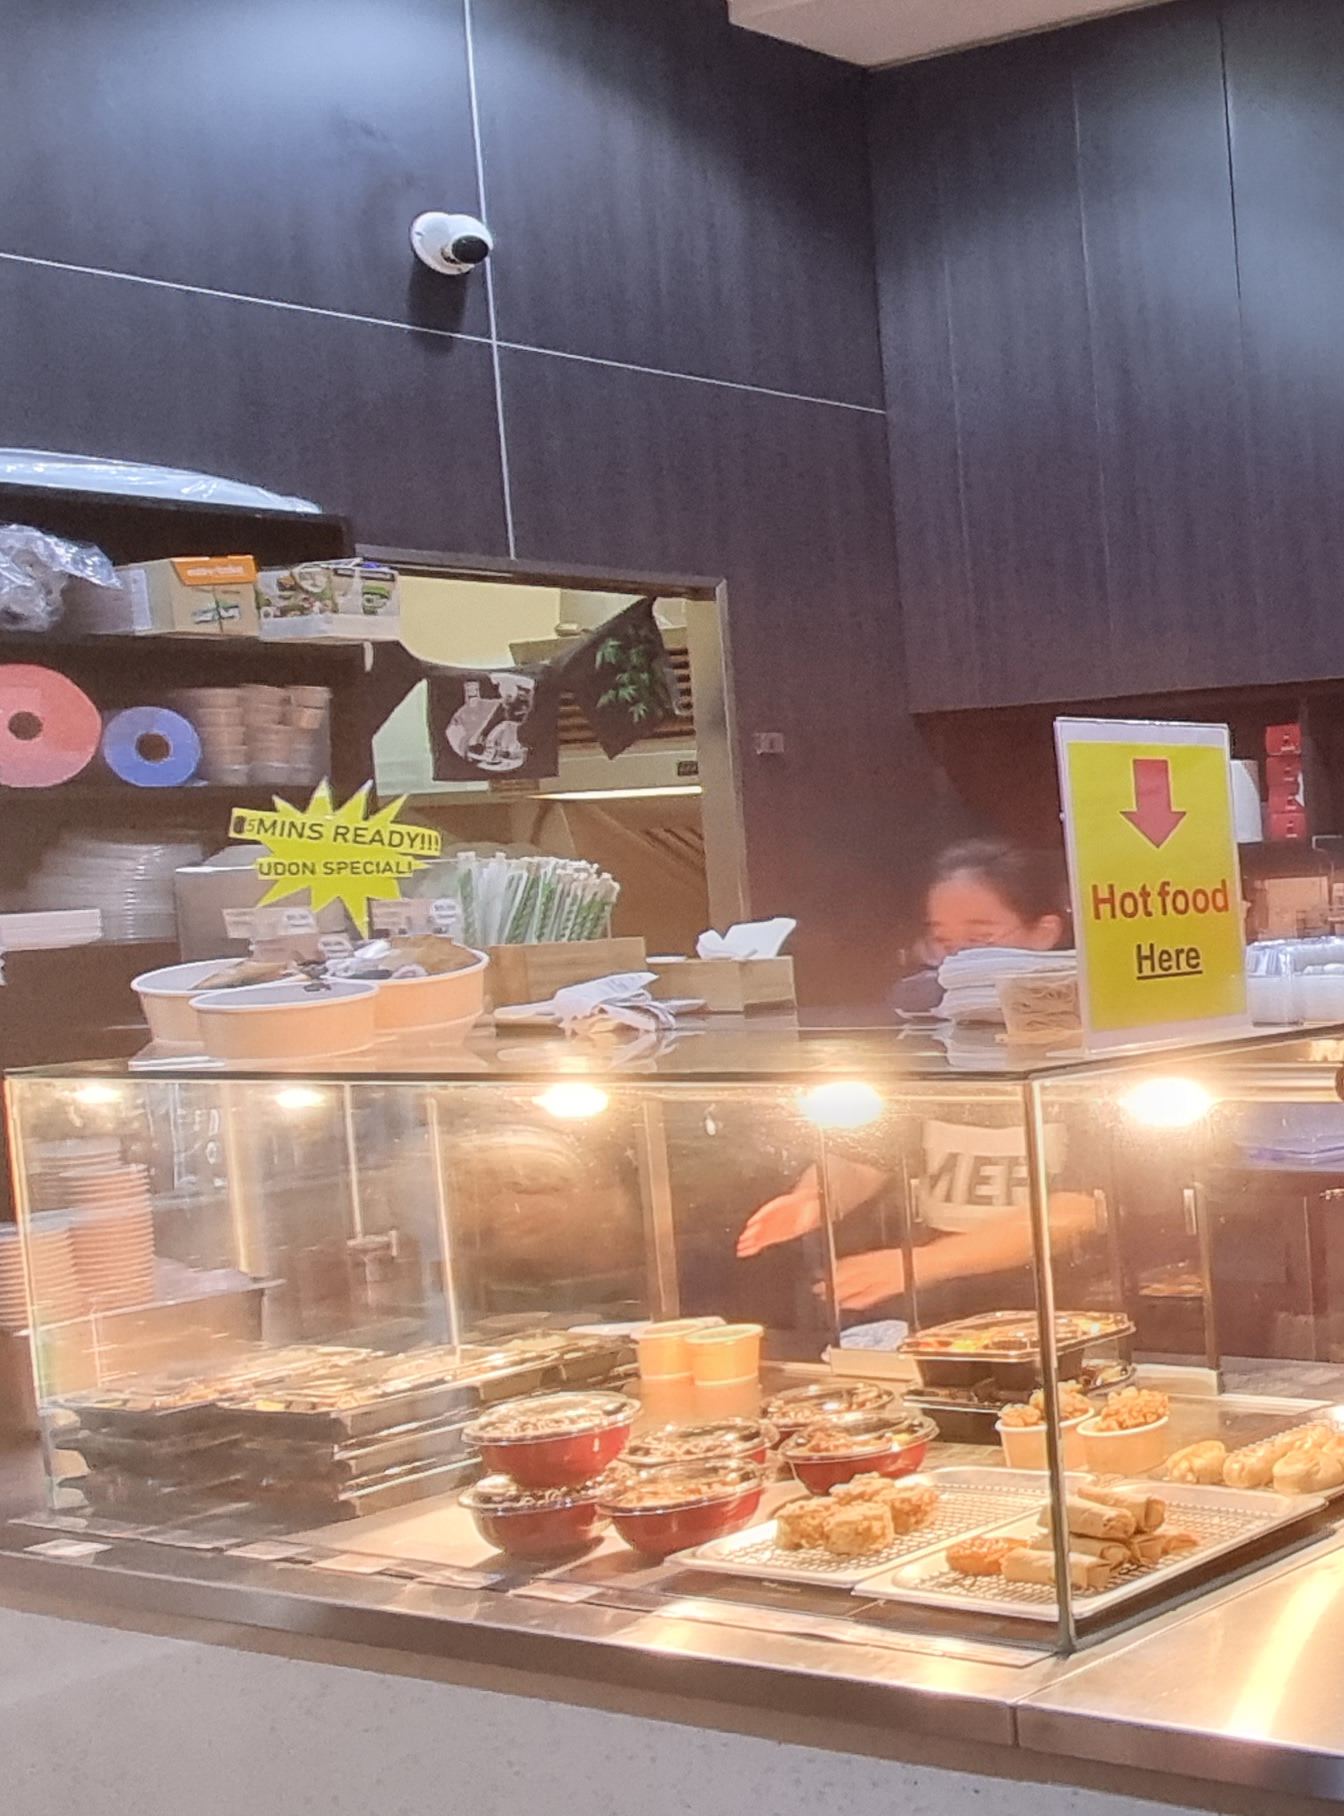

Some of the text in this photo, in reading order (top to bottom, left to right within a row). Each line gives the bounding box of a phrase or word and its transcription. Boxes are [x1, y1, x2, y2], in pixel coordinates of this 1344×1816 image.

[333, 825, 439, 851] READY!!!
[258, 860, 413, 876] UDON SPECIAL!
[1092, 879, 1229, 920] Hot food
[1136, 943, 1201, 974] Here
